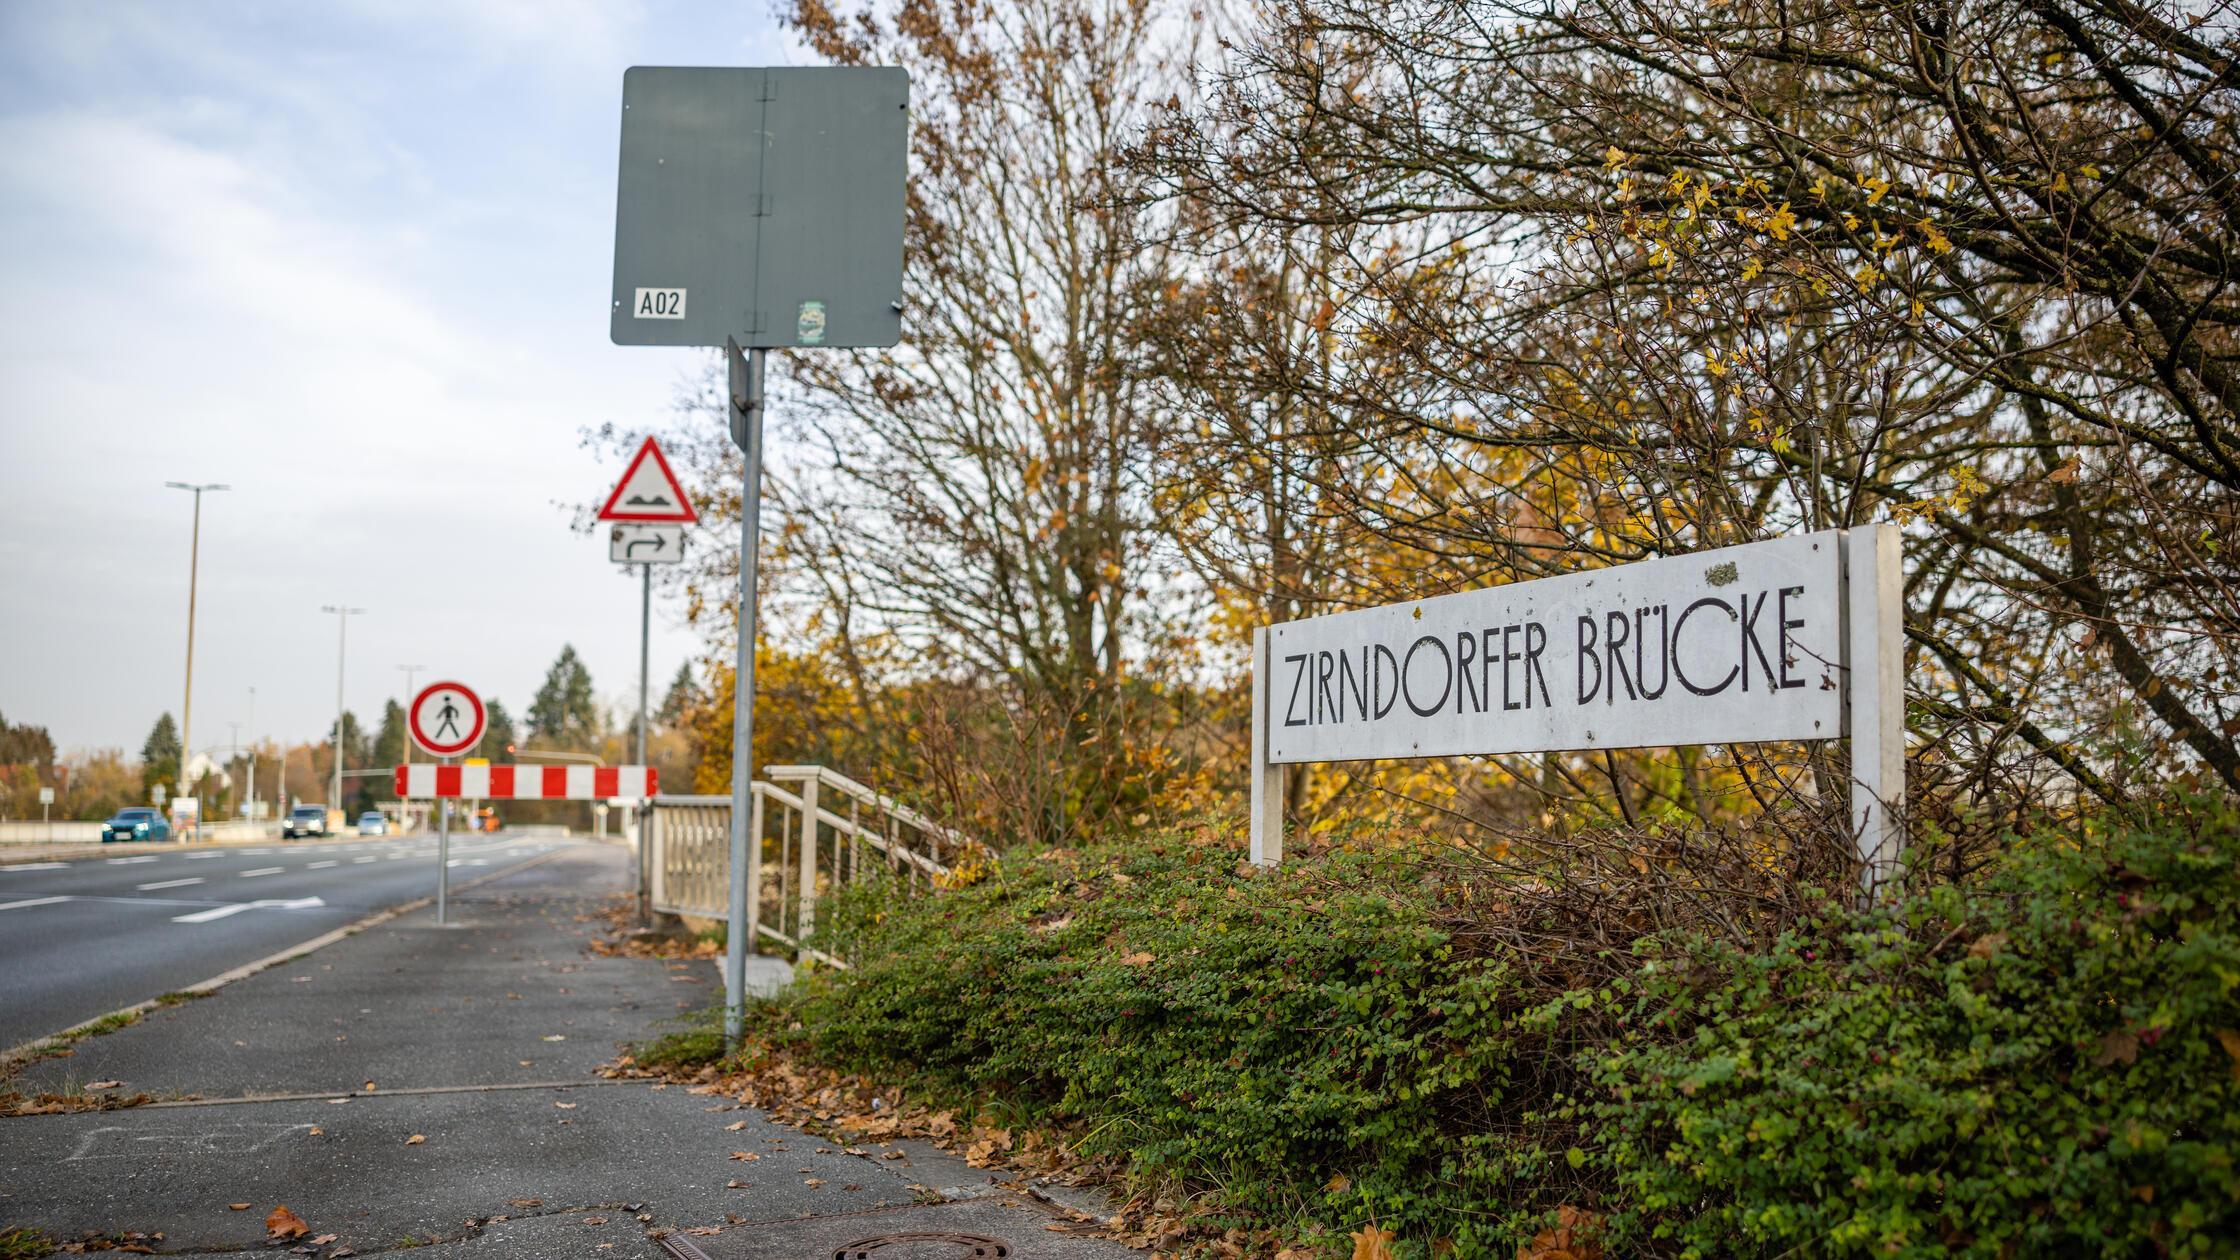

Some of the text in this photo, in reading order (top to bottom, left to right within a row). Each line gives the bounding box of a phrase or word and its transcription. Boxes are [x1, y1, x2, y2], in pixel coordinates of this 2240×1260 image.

[640, 291, 679, 315] A02
[1284, 585, 1805, 727] ZIRNDORFER BRÜCKE
